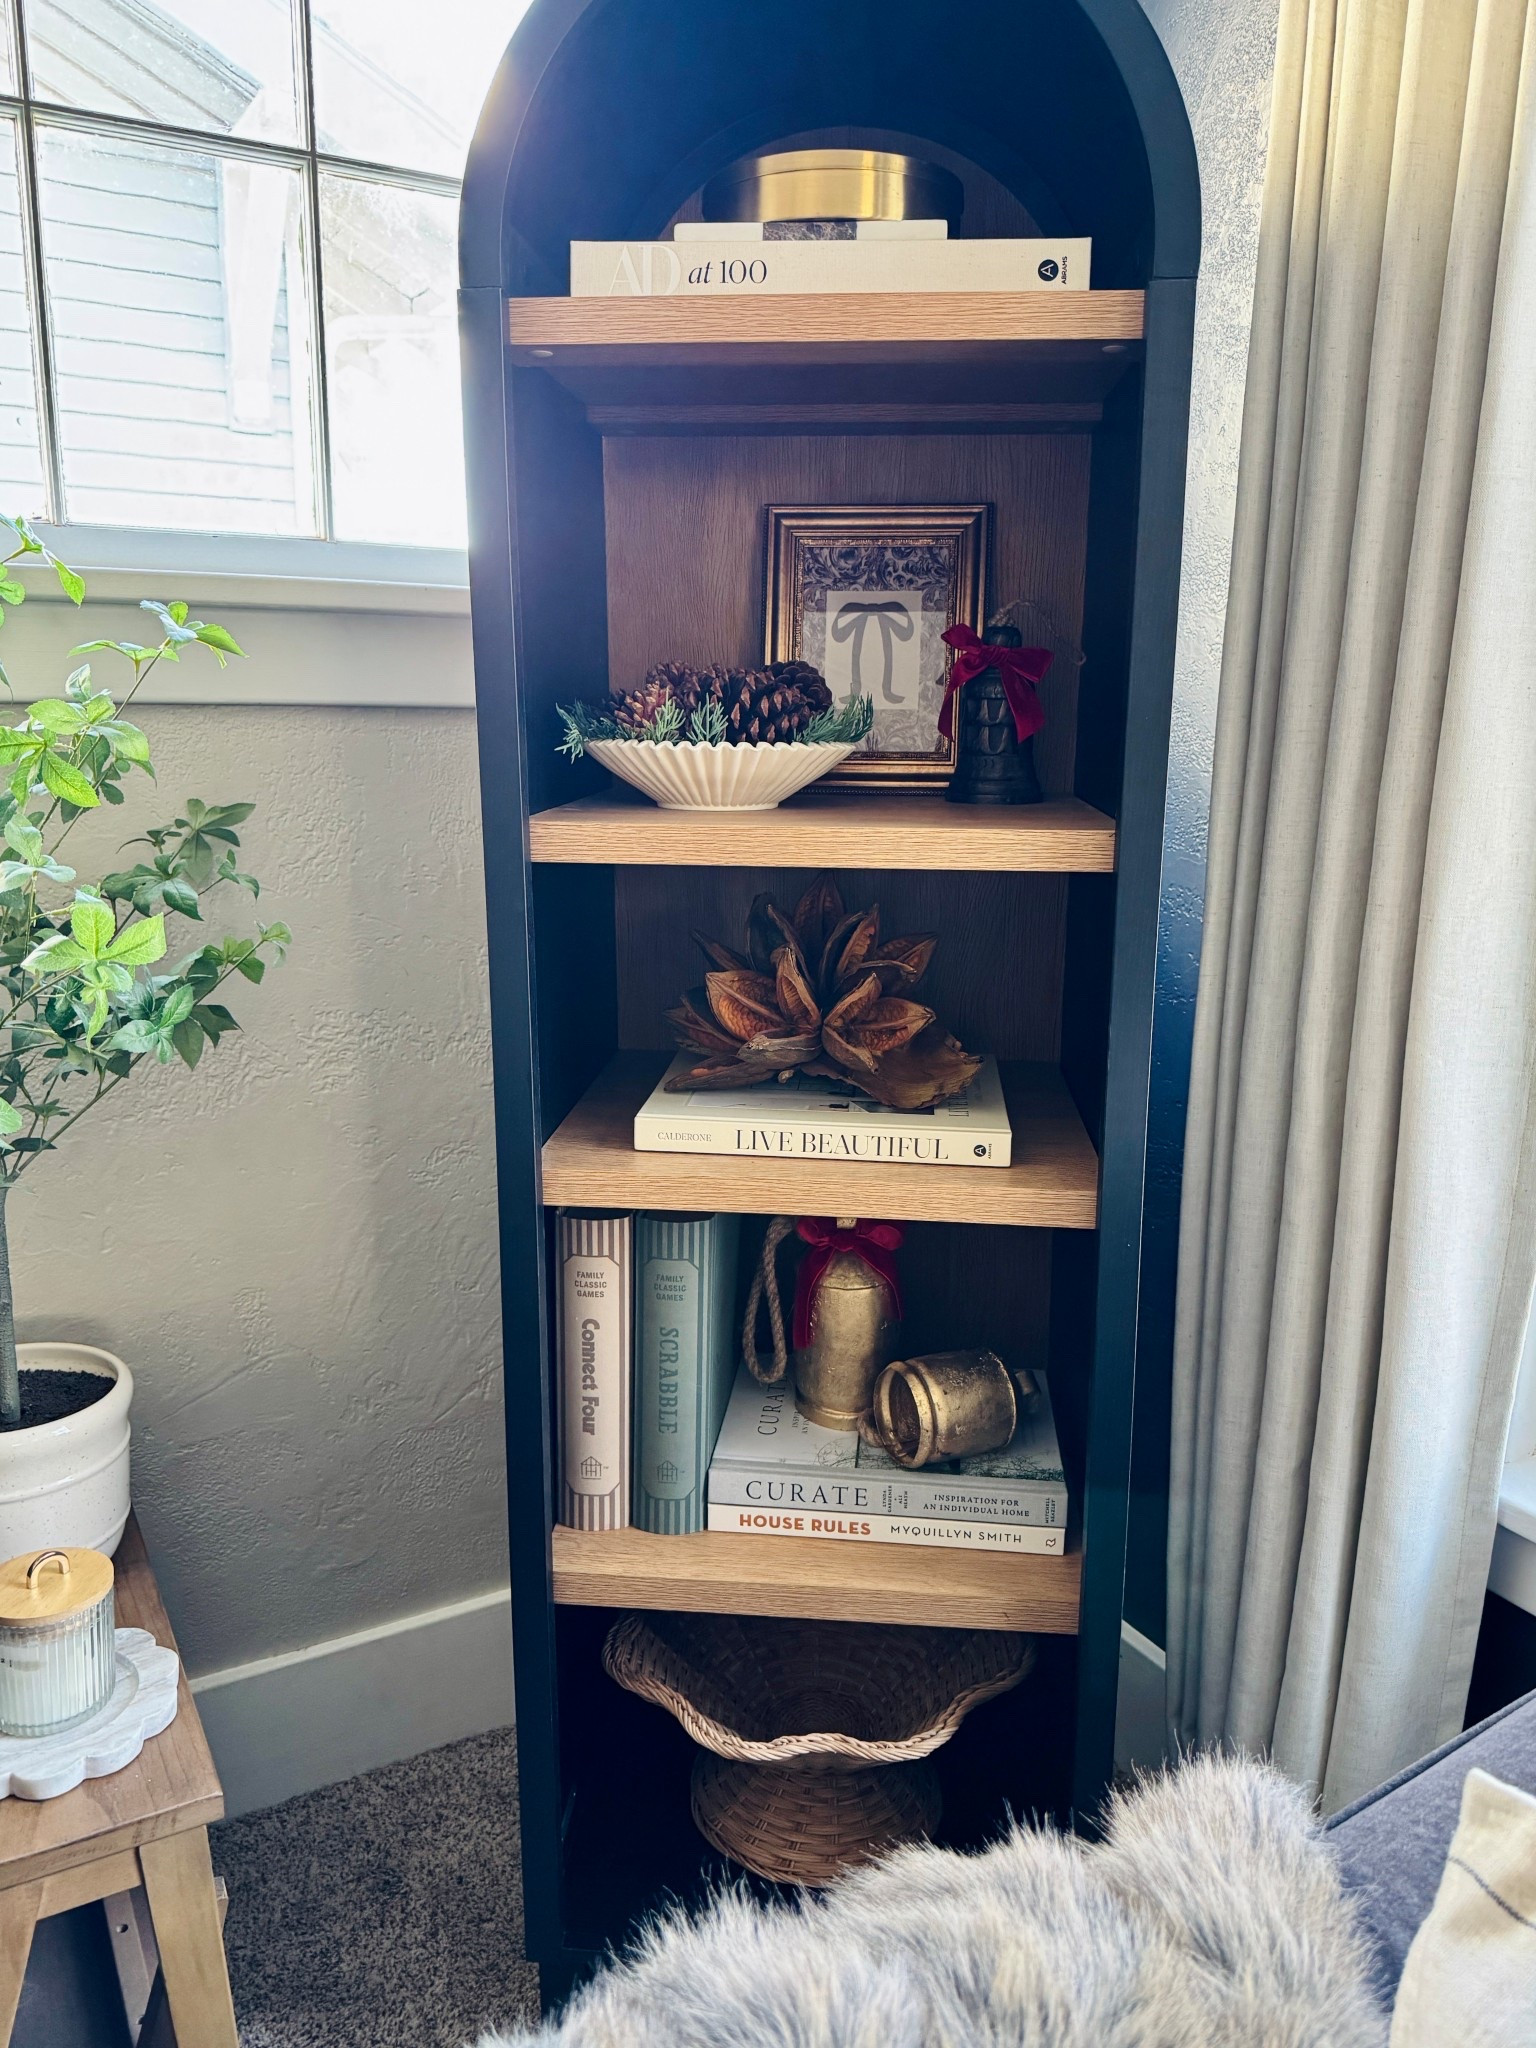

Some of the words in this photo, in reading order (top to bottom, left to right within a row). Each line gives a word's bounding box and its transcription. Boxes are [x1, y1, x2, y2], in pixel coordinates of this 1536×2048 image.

[608, 244, 681, 296] AD
[688, 261, 713, 284] at
[719, 259, 767, 284] 100
[657, 1131, 712, 1142] CALDERONE
[735, 1129, 793, 1152] LIVE
[801, 1132, 949, 1160] BEAUTIFUL
[576, 1270, 605, 1279] FAMILY
[656, 1273, 684, 1283] FAMILY
[574, 1280, 607, 1288] CLASSIC
[653, 1283, 687, 1292] CLASSIC
[576, 1290, 605, 1298] GAMES
[656, 1293, 684, 1302] GAMES
[581, 1318, 600, 1391] Connect
[658, 1327, 679, 1434] SCRABBLE
[582, 1396, 599, 1435] Four
[745, 1480, 869, 1507] CURATE
[934, 1494, 997, 1505] INSPIRATION
[1001, 1499, 1019, 1507] FOR
[939, 1504, 998, 1515] INDIVIDUAL
[1002, 1509, 1030, 1517] HOME
[739, 1513, 805, 1531] HOUSE
[811, 1518, 871, 1536] RULES
[890, 1525, 972, 1539] MYQUILLYN
[978, 1531, 1022, 1543] SMITH
